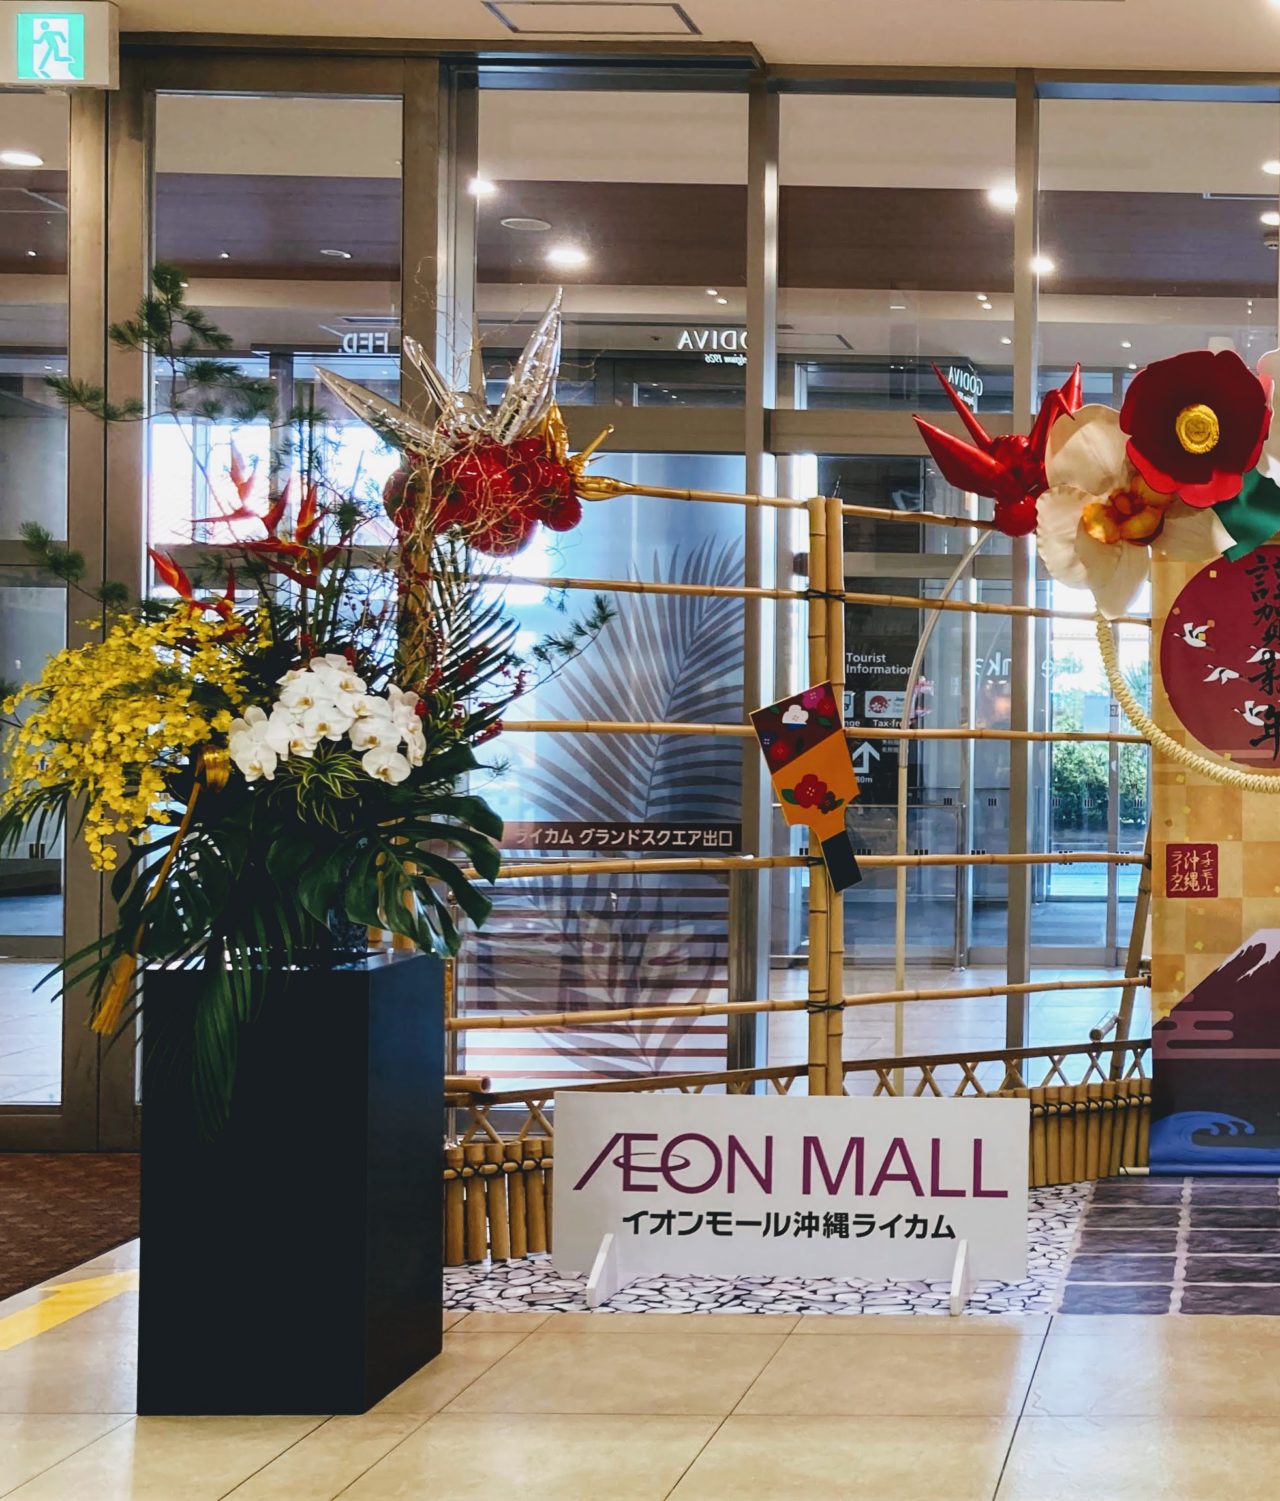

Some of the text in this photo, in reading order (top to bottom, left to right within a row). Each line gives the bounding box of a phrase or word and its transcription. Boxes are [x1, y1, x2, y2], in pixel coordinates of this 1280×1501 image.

[846, 653, 887, 663] Tourist
[580, 828, 733, 847] グランドスクエア出口
[801, 1135, 1009, 1199] MALL
[621, 1209, 957, 1240] イオンモール沖縄ライカム
